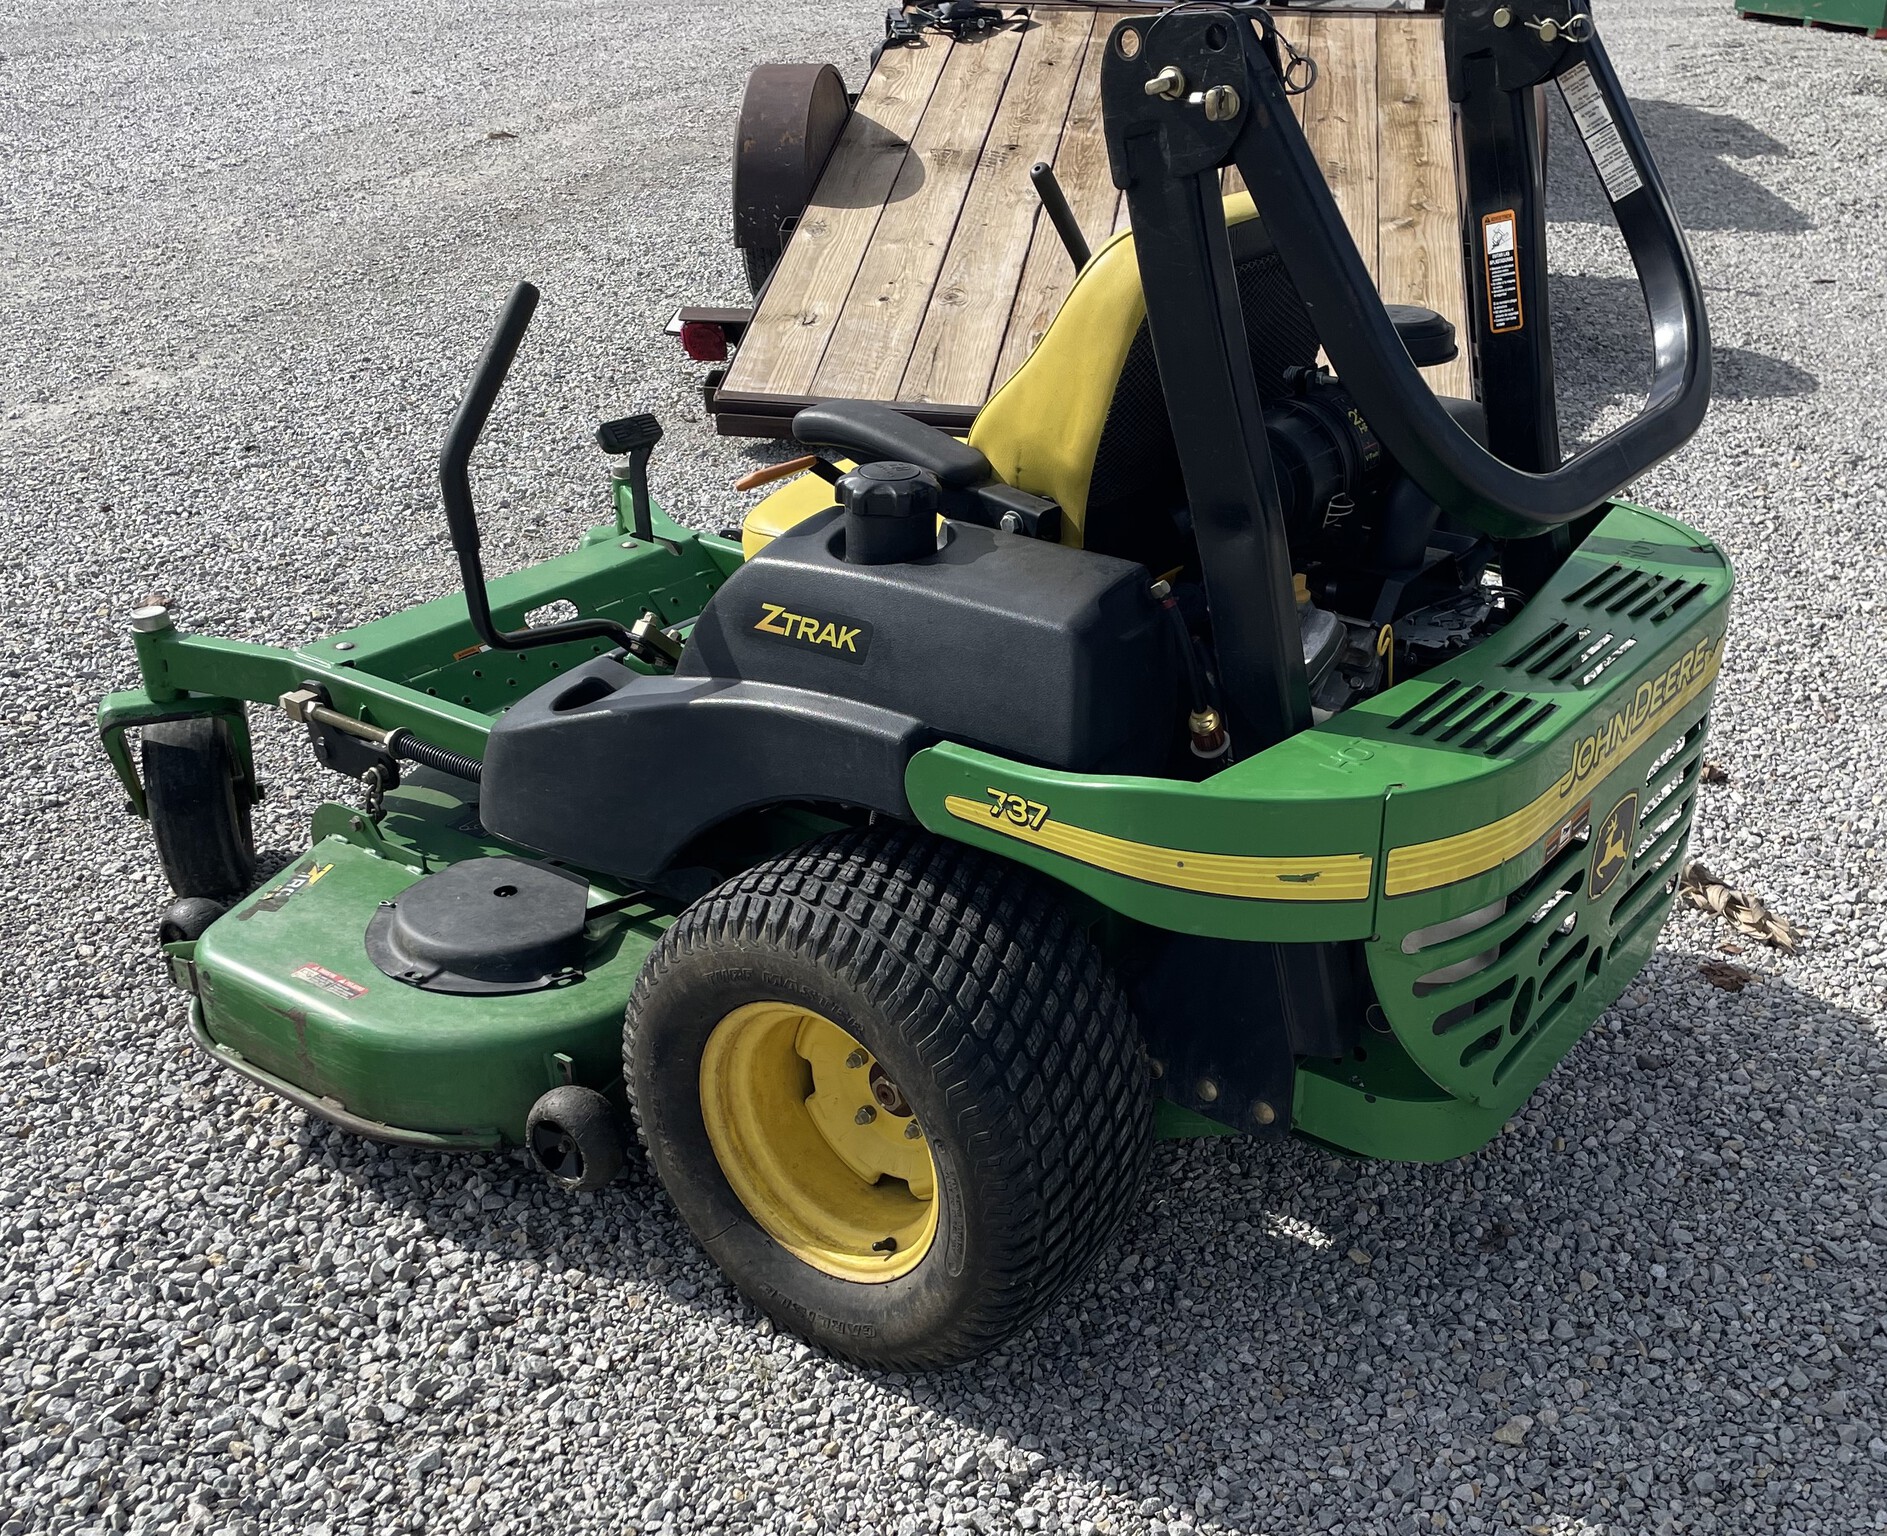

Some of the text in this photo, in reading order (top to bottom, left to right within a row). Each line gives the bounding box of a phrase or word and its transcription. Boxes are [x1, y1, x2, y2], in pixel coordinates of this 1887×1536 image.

[753, 602, 862, 653] ZTRAK
[1559, 636, 1709, 799] JOHN DEERE
[986, 786, 1050, 832] 737
[702, 966, 866, 1033] TURF MASTER
